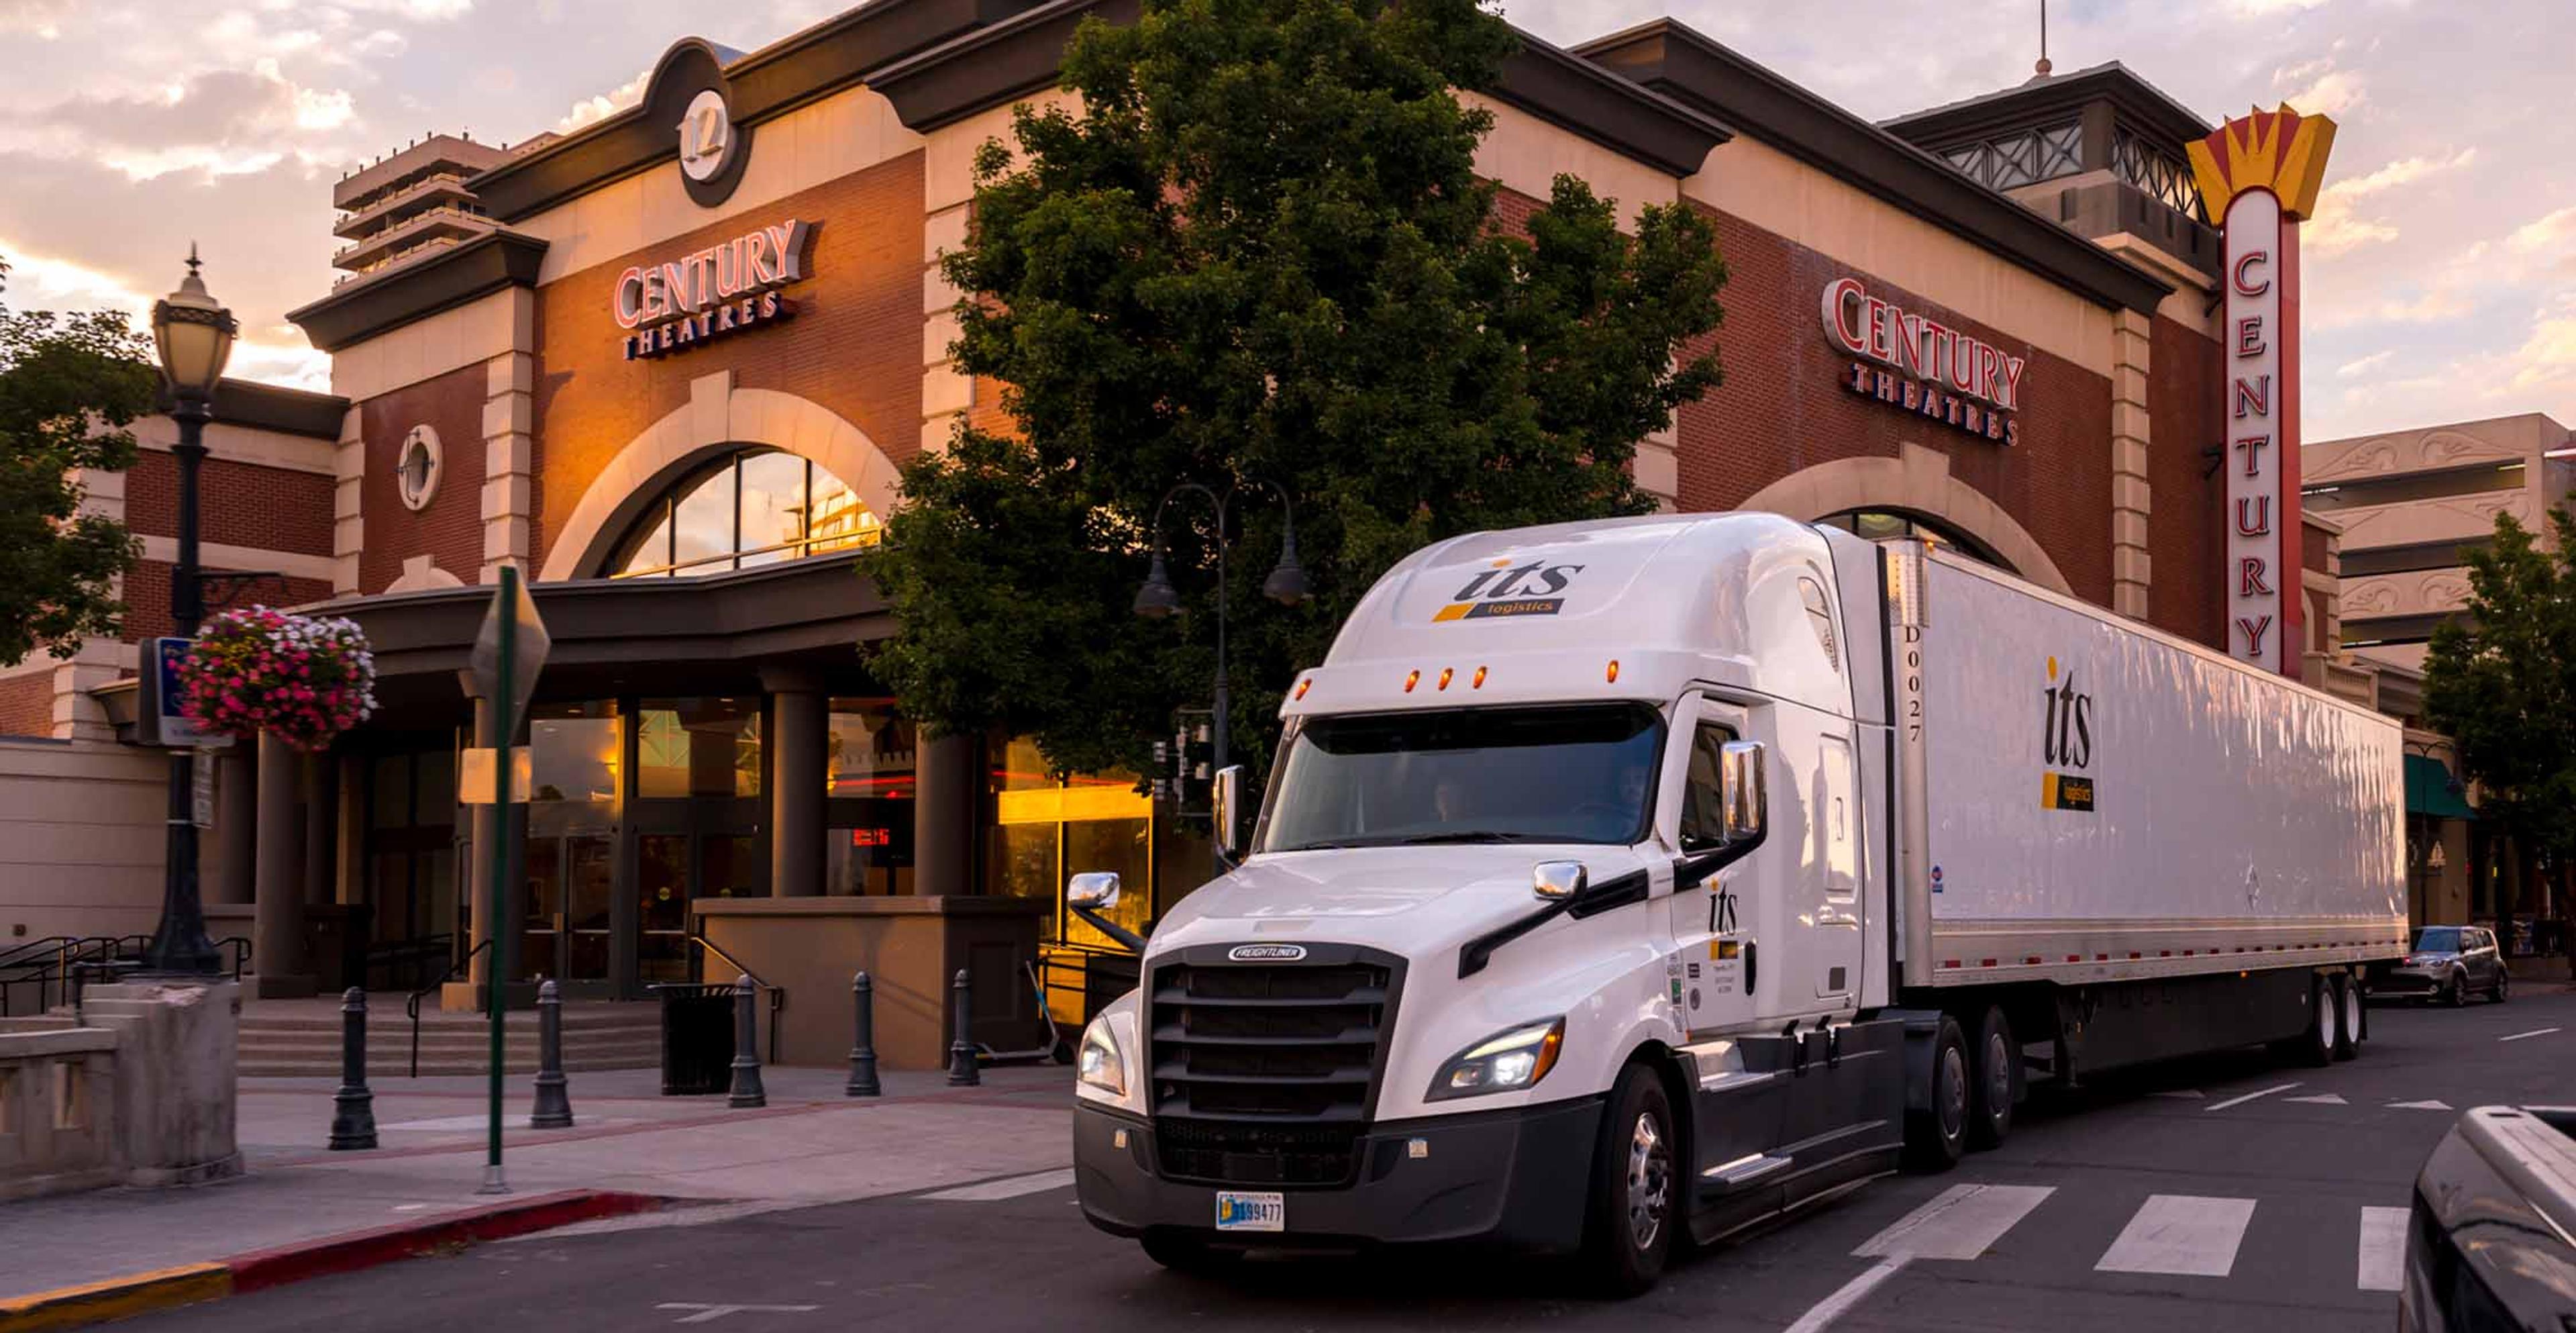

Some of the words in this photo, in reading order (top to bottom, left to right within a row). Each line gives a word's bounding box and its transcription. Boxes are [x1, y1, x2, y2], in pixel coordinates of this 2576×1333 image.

[613, 218, 800, 329] CENTURY
[623, 290, 781, 360] THEATRES
[1824, 277, 2025, 411] CENTURY
[1851, 362, 2019, 446] THEATRES
[2232, 250, 2273, 656] CENTURY
[1453, 558, 1586, 602] its
[1487, 601, 1554, 615] logistics
[1905, 626, 1922, 742] D0027
[2043, 655, 2092, 769] its
[1709, 878, 1738, 936] its
[1235, 948, 1298, 958] FREIGHTLINER
